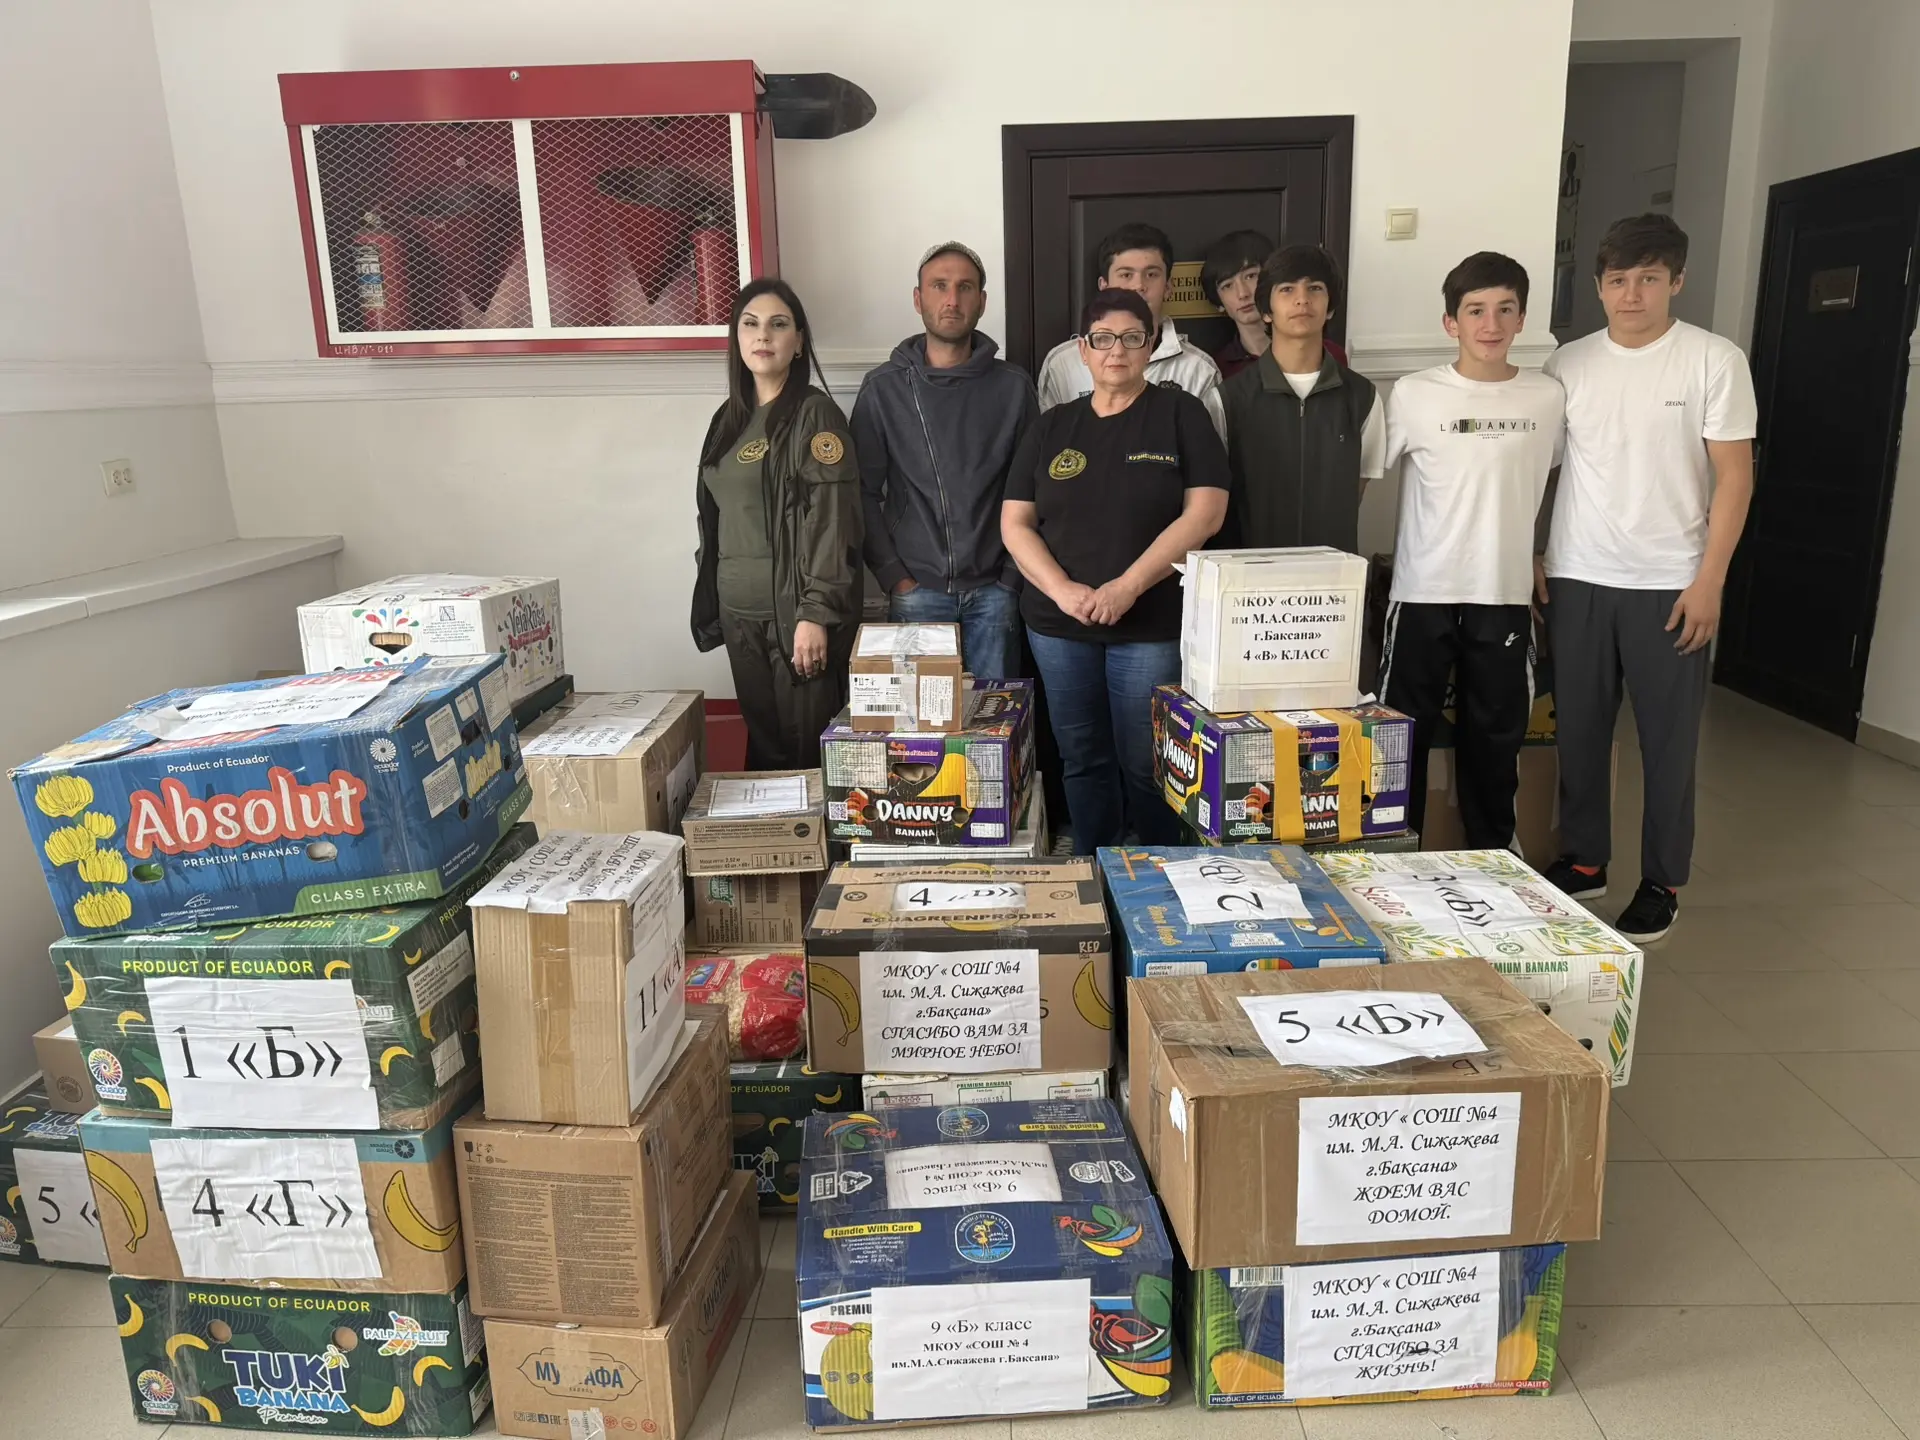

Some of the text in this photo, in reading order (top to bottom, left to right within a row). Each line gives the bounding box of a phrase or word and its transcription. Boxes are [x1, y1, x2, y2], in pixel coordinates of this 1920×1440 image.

[1232, 594, 1347, 608] МКОУ «СОШ №4
[1231, 613, 1346, 626] им М.А.Сижажева
[1254, 630, 1322, 643] г.Баксана»
[1243, 648, 1330, 662] 4 «В» КЛАСС
[167, 754, 270, 774] Product of Ecuador
[1163, 730, 1196, 780] DANNY
[135, 771, 360, 853] Absolut
[876, 799, 953, 822] DANNY
[895, 827, 936, 837] BANANA
[1229, 827, 1271, 837] Quality Fruit
[1235, 822, 1266, 830] Premium
[1304, 819, 1337, 831] ANANA
[183, 846, 301, 869] PREMIUM BANANAS
[311, 880, 427, 905] CLASS EXTRA
[909, 887, 932, 907] 4
[1216, 891, 1265, 912] 2
[1434, 886, 1495, 928] «Б»
[862, 911, 1058, 924] ECUAGREENPRODEX
[1079, 940, 1101, 954] RED
[123, 959, 314, 974] PRODUCT OF ECUADOR
[883, 963, 938, 979] МКОУ
[951, 961, 994, 977] СОШ
[995, 961, 1021, 975] №4
[1526, 960, 1569, 973] BANANAS
[882, 982, 1024, 999] им. М.А. Сижажева
[915, 1005, 992, 1020] г.Баксана»
[881, 1022, 1029, 1041] СПАСИБО ВАМ ЗА
[1277, 1003, 1445, 1044] 5 «Б»
[172, 1025, 344, 1079] 1 «Б»
[891, 1042, 1022, 1060] МИРНОЕ НЕБО!
[731, 1085, 791, 1093] OF ECUADOR
[1328, 1109, 1398, 1130] МКОУ
[1412, 1106, 1465, 1126] СОШ
[1466, 1105, 1498, 1123] №4
[1069, 1123, 1099, 1131] Handle
[1326, 1131, 1500, 1155] им. М.А. Сижажева
[948, 1171, 983, 1181] «СОШ
[986, 1168, 1022, 1177] МКОУ
[1366, 1159, 1458, 1178] г.Баксана»
[924, 1174, 931, 1182] 4
[923, 1181, 1017, 1196] 9 «Б» класс
[1353, 1181, 1470, 1202] ЖДЕМ ВАС
[38, 1186, 61, 1224] 5
[191, 1177, 354, 1229] 4 «Г»
[1368, 1204, 1451, 1226] ДОМОЙ.
[831, 1224, 914, 1237] Handle With Care
[1313, 1274, 1381, 1297] МКОУ
[1395, 1268, 1449, 1290] СОШ
[1446, 1266, 1477, 1283] №4
[188, 1292, 371, 1312] PRODUCT OF ECUADOR
[830, 1303, 872, 1316] PREMIU
[1310, 1291, 1481, 1321] им. М.А. Сижажева
[931, 1318, 1033, 1335] 9 «Б» класс
[1350, 1319, 1441, 1338] г.Баксана»
[923, 1338, 1029, 1353] МКОУ «СОШ № 4
[1333, 1337, 1459, 1362] СПАСИБО ЗА
[891, 1353, 1060, 1369] им.М.А.Сижажева г.Баксана»
[1354, 1359, 1437, 1380] ЖИЗНЬ!
[535, 1360, 624, 1389] МУАФА
[1480, 1381, 1514, 1389] PREMIUM
[235, 1385, 351, 1413] BANANA
[1211, 1395, 1245, 1403] PRODUCT
[1257, 1393, 1286, 1401] ECUAD
[257, 1405, 329, 1425] Premium
